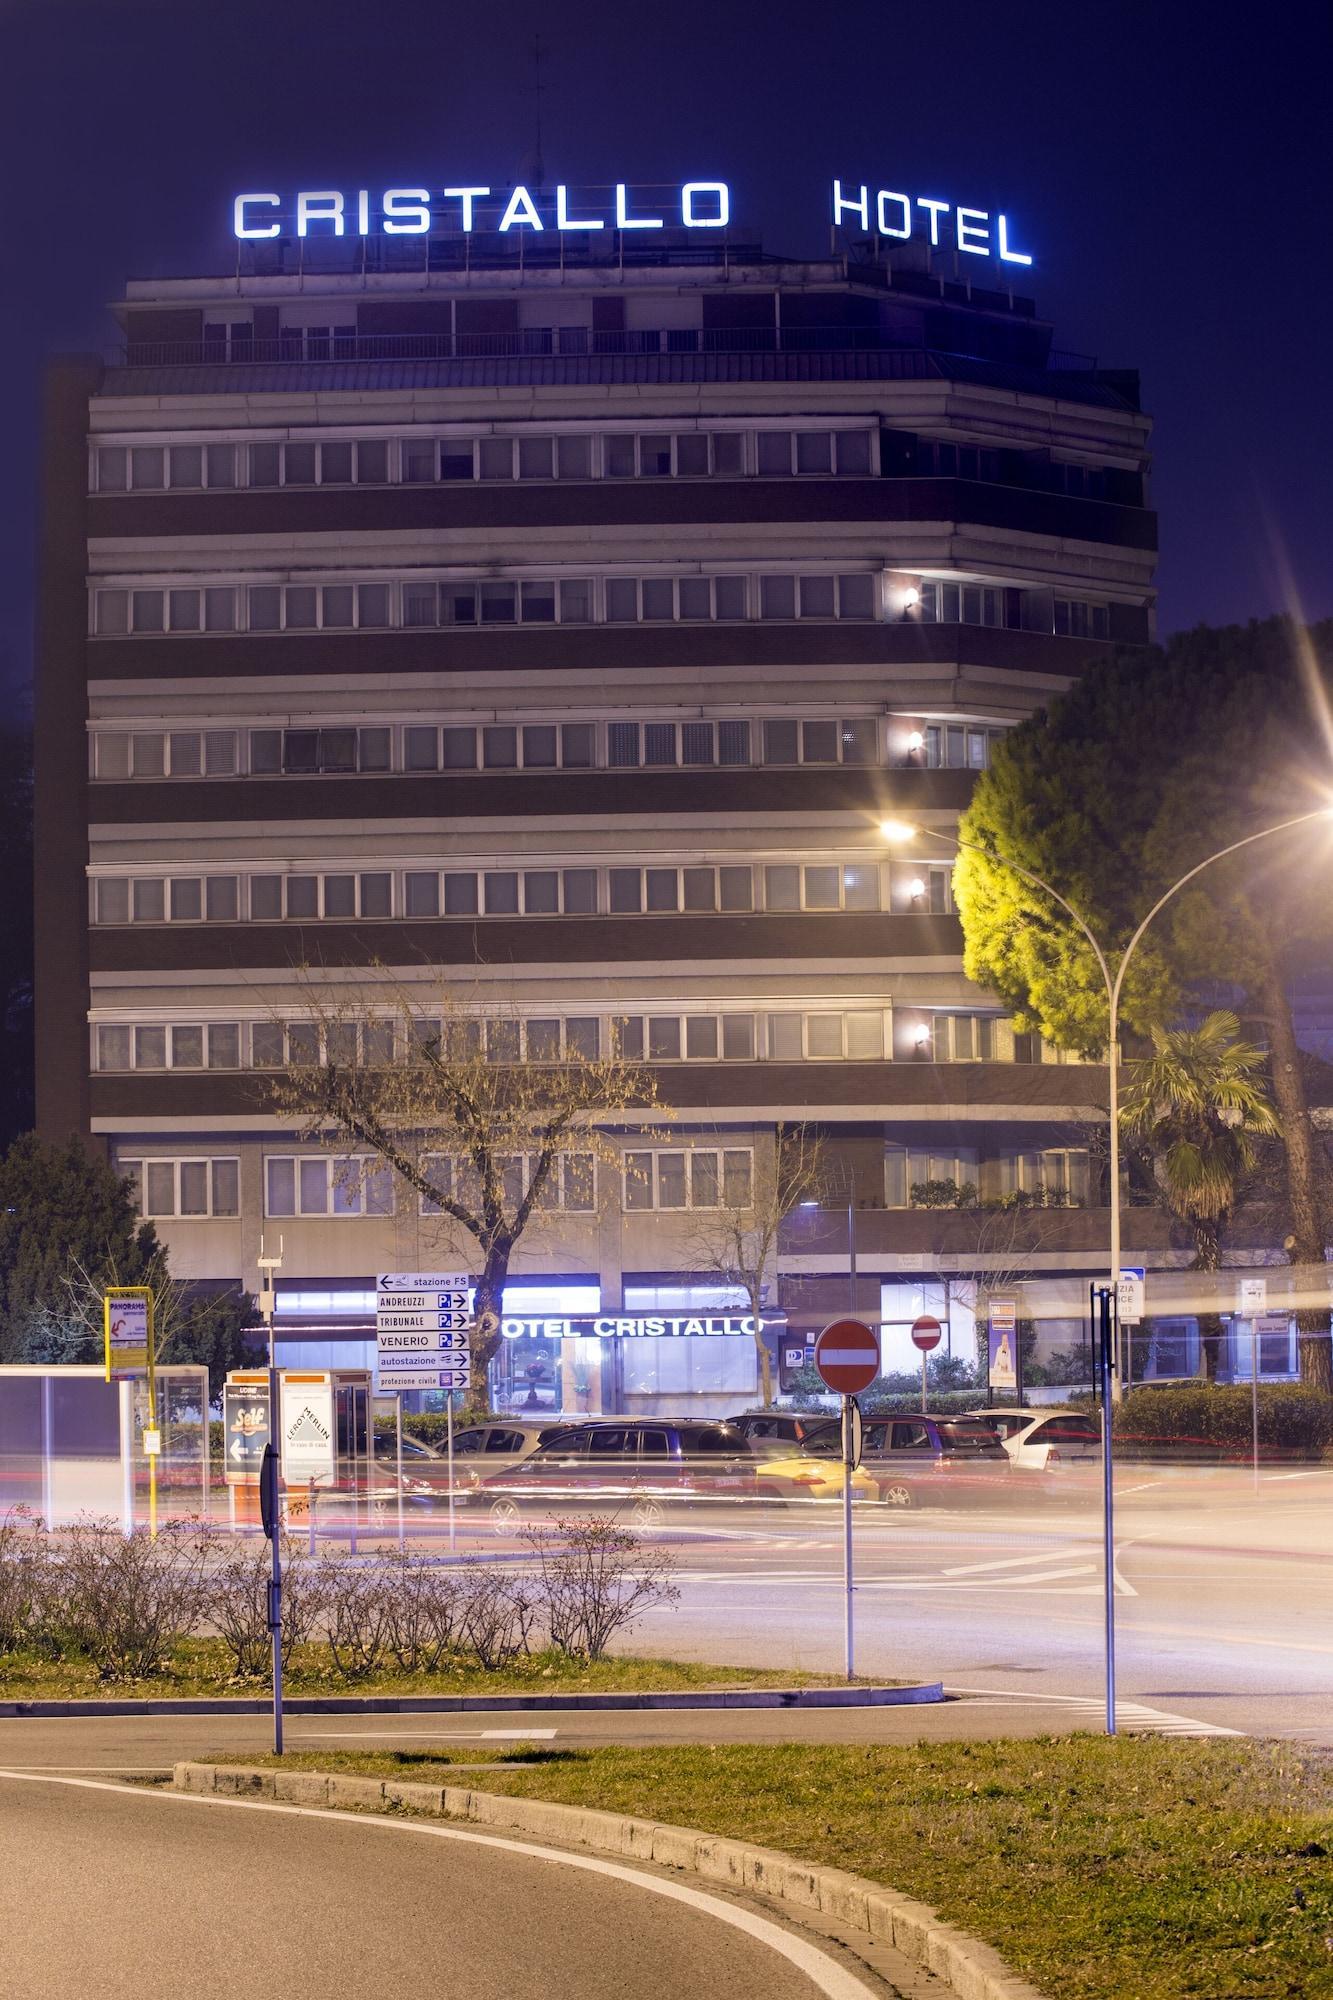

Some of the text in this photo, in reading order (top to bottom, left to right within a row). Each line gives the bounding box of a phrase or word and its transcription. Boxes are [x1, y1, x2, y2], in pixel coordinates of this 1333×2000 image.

[233, 179, 1033, 265] CRISTALLO HOTEL
[414, 1277, 466, 1286] stazione FS
[380, 1297, 425, 1306] ANDREUZZI
[380, 1317, 424, 1326] TRIBUNALE
[501, 1317, 764, 1338] OTEL CRISTALLO
[380, 1336, 429, 1346] VENERIO
[381, 1357, 436, 1366] autostazione
[381, 1376, 437, 1386] protezione civile
[287, 1406, 330, 1440] LEROY MERLIN
